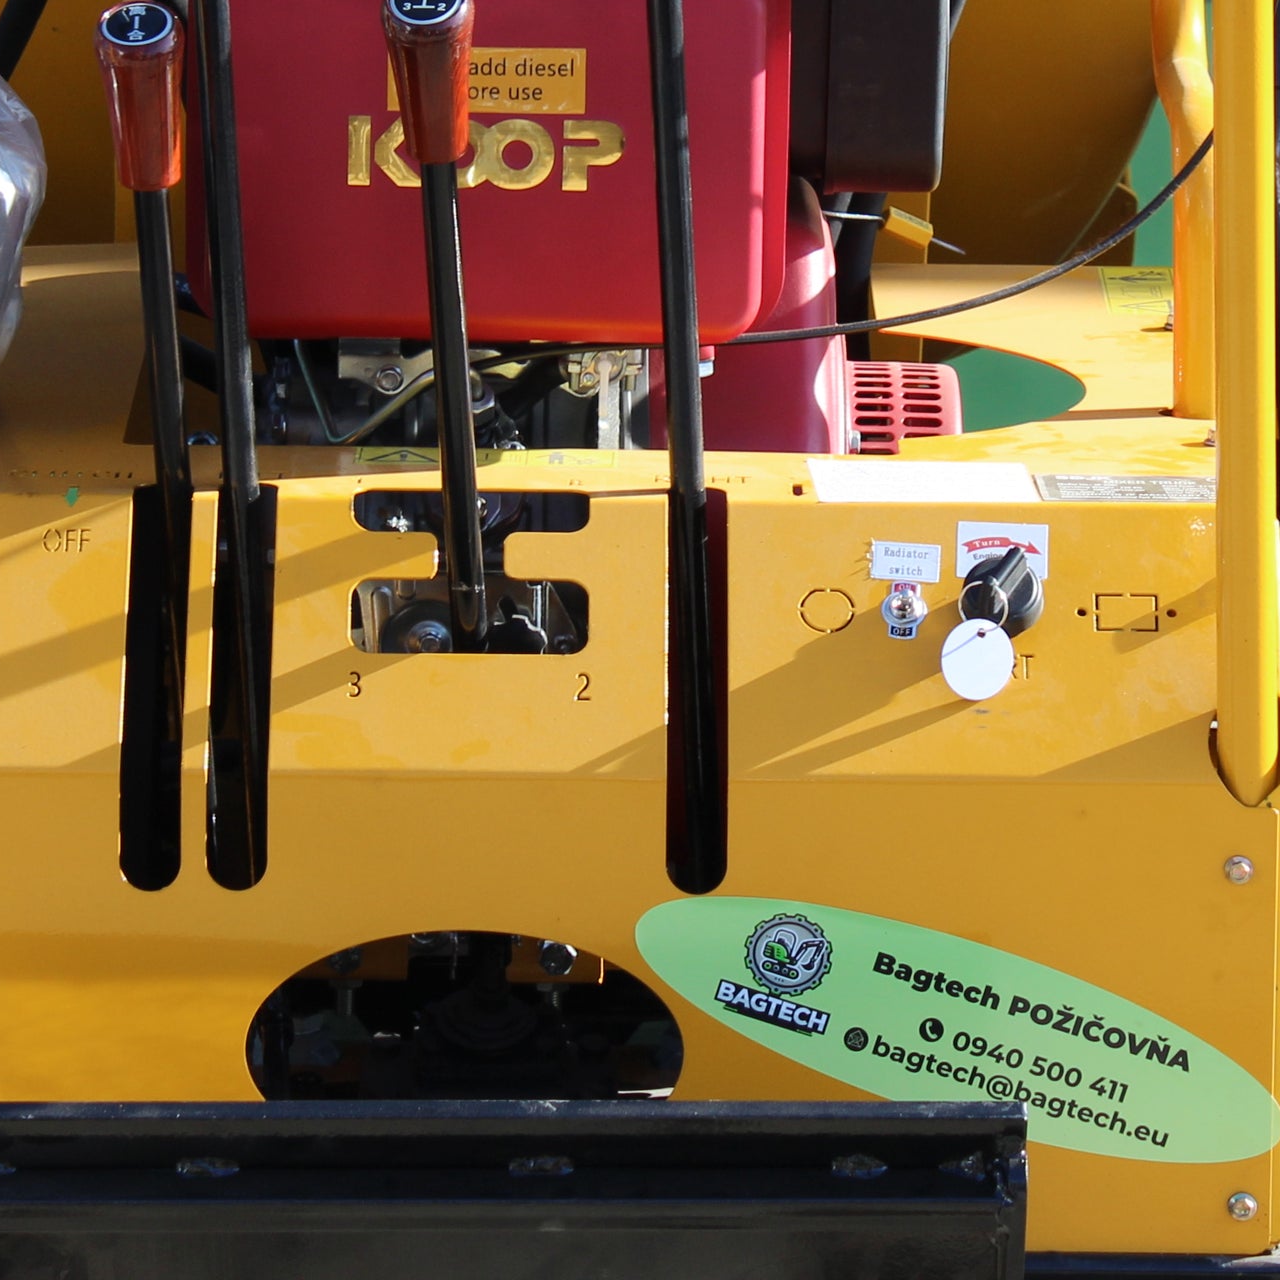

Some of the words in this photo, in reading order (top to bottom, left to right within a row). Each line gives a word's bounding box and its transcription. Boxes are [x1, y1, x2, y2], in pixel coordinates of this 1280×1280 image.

[437, 3, 446, 11] 2
[468, 58, 506, 76] add
[515, 58, 575, 77] diesel
[468, 86, 500, 100] ore
[508, 86, 543, 100] use
[41, 528, 92, 553] OFF
[972, 539, 1001, 548] Turn
[883, 547, 929, 560] Radiator
[889, 567, 923, 577] switch
[893, 627, 911, 636] OFF
[346, 671, 362, 698] 3
[574, 673, 591, 701] 2
[716, 981, 827, 1033] BAGTECH
[873, 951, 1001, 1010] Bagtech
[1007, 995, 1191, 1072] POŽIČOVŇA
[952, 1031, 1024, 1070] 0940
[1029, 1056, 1083, 1088] 500
[1088, 1075, 1130, 1104] 411
[871, 1035, 1170, 1148] bagtech@bagtech.eu
